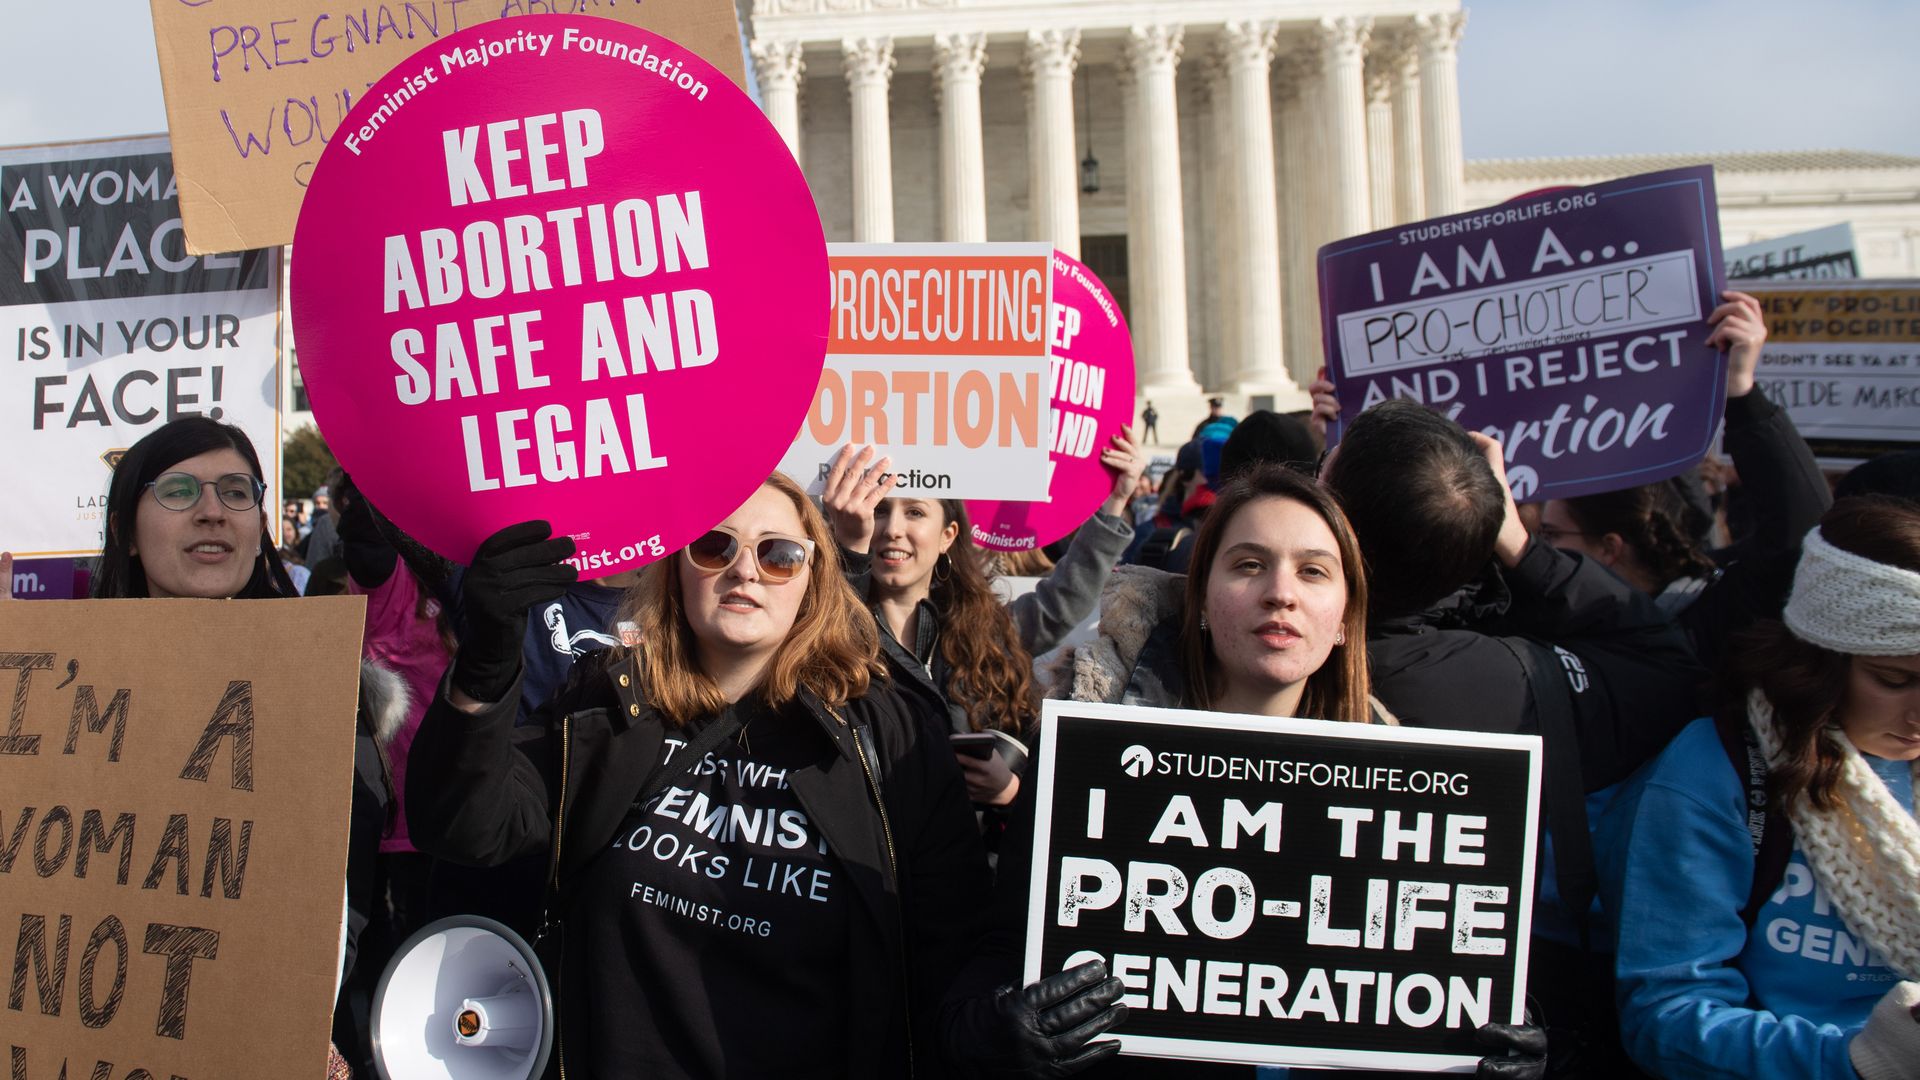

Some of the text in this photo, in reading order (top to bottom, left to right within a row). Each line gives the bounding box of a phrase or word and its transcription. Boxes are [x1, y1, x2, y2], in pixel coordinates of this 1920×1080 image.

[210, 0, 468, 82] PREGNANT
[219, 82, 374, 158] WOU
[344, 28, 709, 156] Feminist Majority Foundation
[442, 108, 605, 206] KEEP
[9, 167, 180, 212] A WOMA
[1399, 191, 1598, 246] STUDENTSFORLIFE.ORG
[383, 190, 709, 313] ABORTION
[1370, 227, 1640, 302] I AM A...
[1725, 249, 1777, 275] ACE
[1070, 265, 1119, 328] Foundation
[17, 313, 240, 361] IS IN YOUR
[390, 290, 719, 405] SAFE AND
[1051, 301, 1082, 350] EP
[1773, 320, 1920, 336] HYPOCRITE
[1050, 354, 1107, 411] TION
[1475, 354, 1488, 397] I
[1505, 330, 1688, 392] REJECT
[1824, 354, 1857, 366] SEE
[1861, 355, 1883, 367] YA
[1888, 355, 1910, 367] AT
[32, 365, 224, 431] FACE!
[795, 368, 1039, 448] ORTION
[1760, 378, 1920, 411] PRIDE MARC
[461, 393, 668, 491] LEGAL
[76, 511, 104, 520] JUST
[77, 495, 109, 508] LAD
[552, 534, 666, 571] nist.org
[971, 524, 1036, 549] feminist.org
[13, 572, 46, 593] m.
[0, 651, 254, 792] I'M A
[1157, 752, 1469, 796] STUDENTSFORLIFE.ORG
[1087, 788, 1488, 866] I AM THE
[742, 857, 832, 902] LIKE
[1057, 855, 1510, 956] PRO-LIFE
[631, 881, 771, 937] FEMINIST.ORG
[1766, 917, 1888, 967] GEN
[9, 913, 220, 1040] NOT
